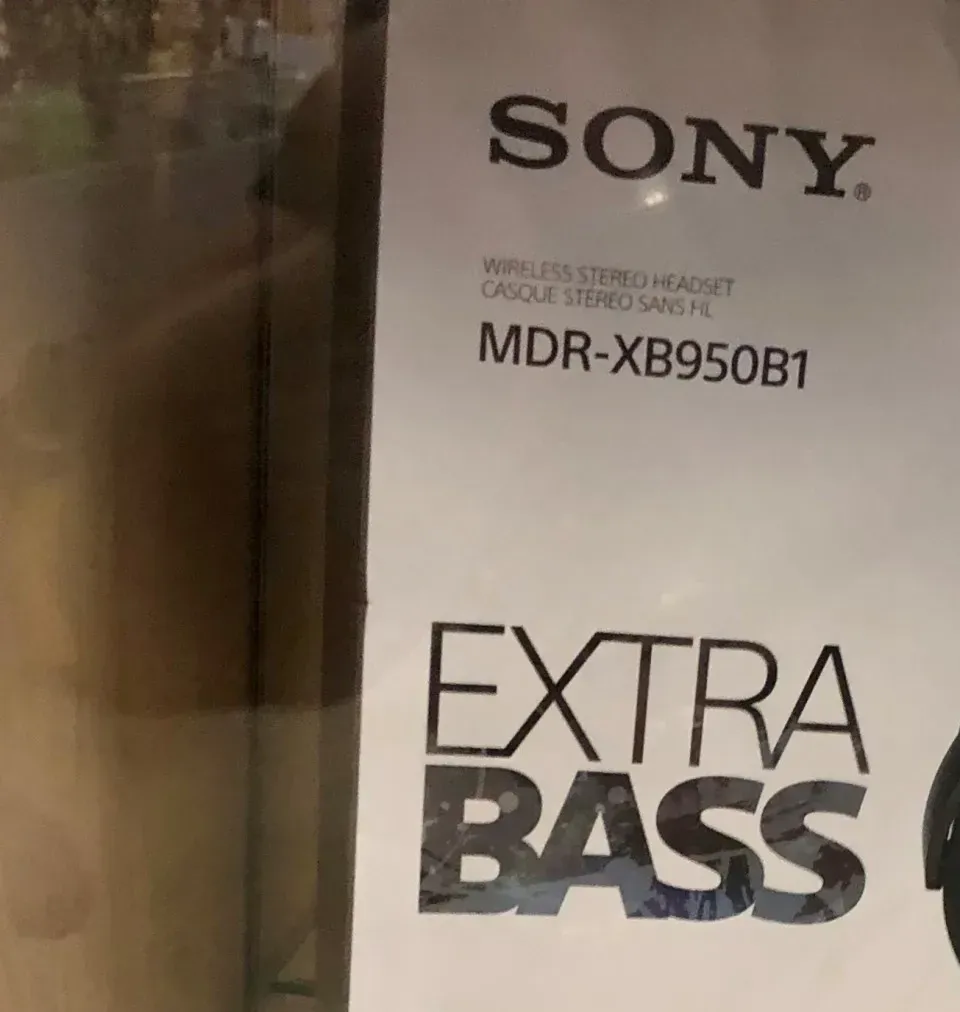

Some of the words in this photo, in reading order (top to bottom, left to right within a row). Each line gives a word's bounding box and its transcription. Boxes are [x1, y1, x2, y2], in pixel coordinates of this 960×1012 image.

[487, 94, 876, 198] SONY
[481, 279, 559, 305] CASQUE
[638, 295, 686, 316] SANS
[482, 257, 573, 284] WIRELESS
[575, 265, 648, 290] STEREO
[652, 273, 736, 297] HEADSET
[478, 321, 809, 390] MDR-XB950B1
[425, 621, 871, 775] EXTRA
[418, 764, 868, 925] BASS
